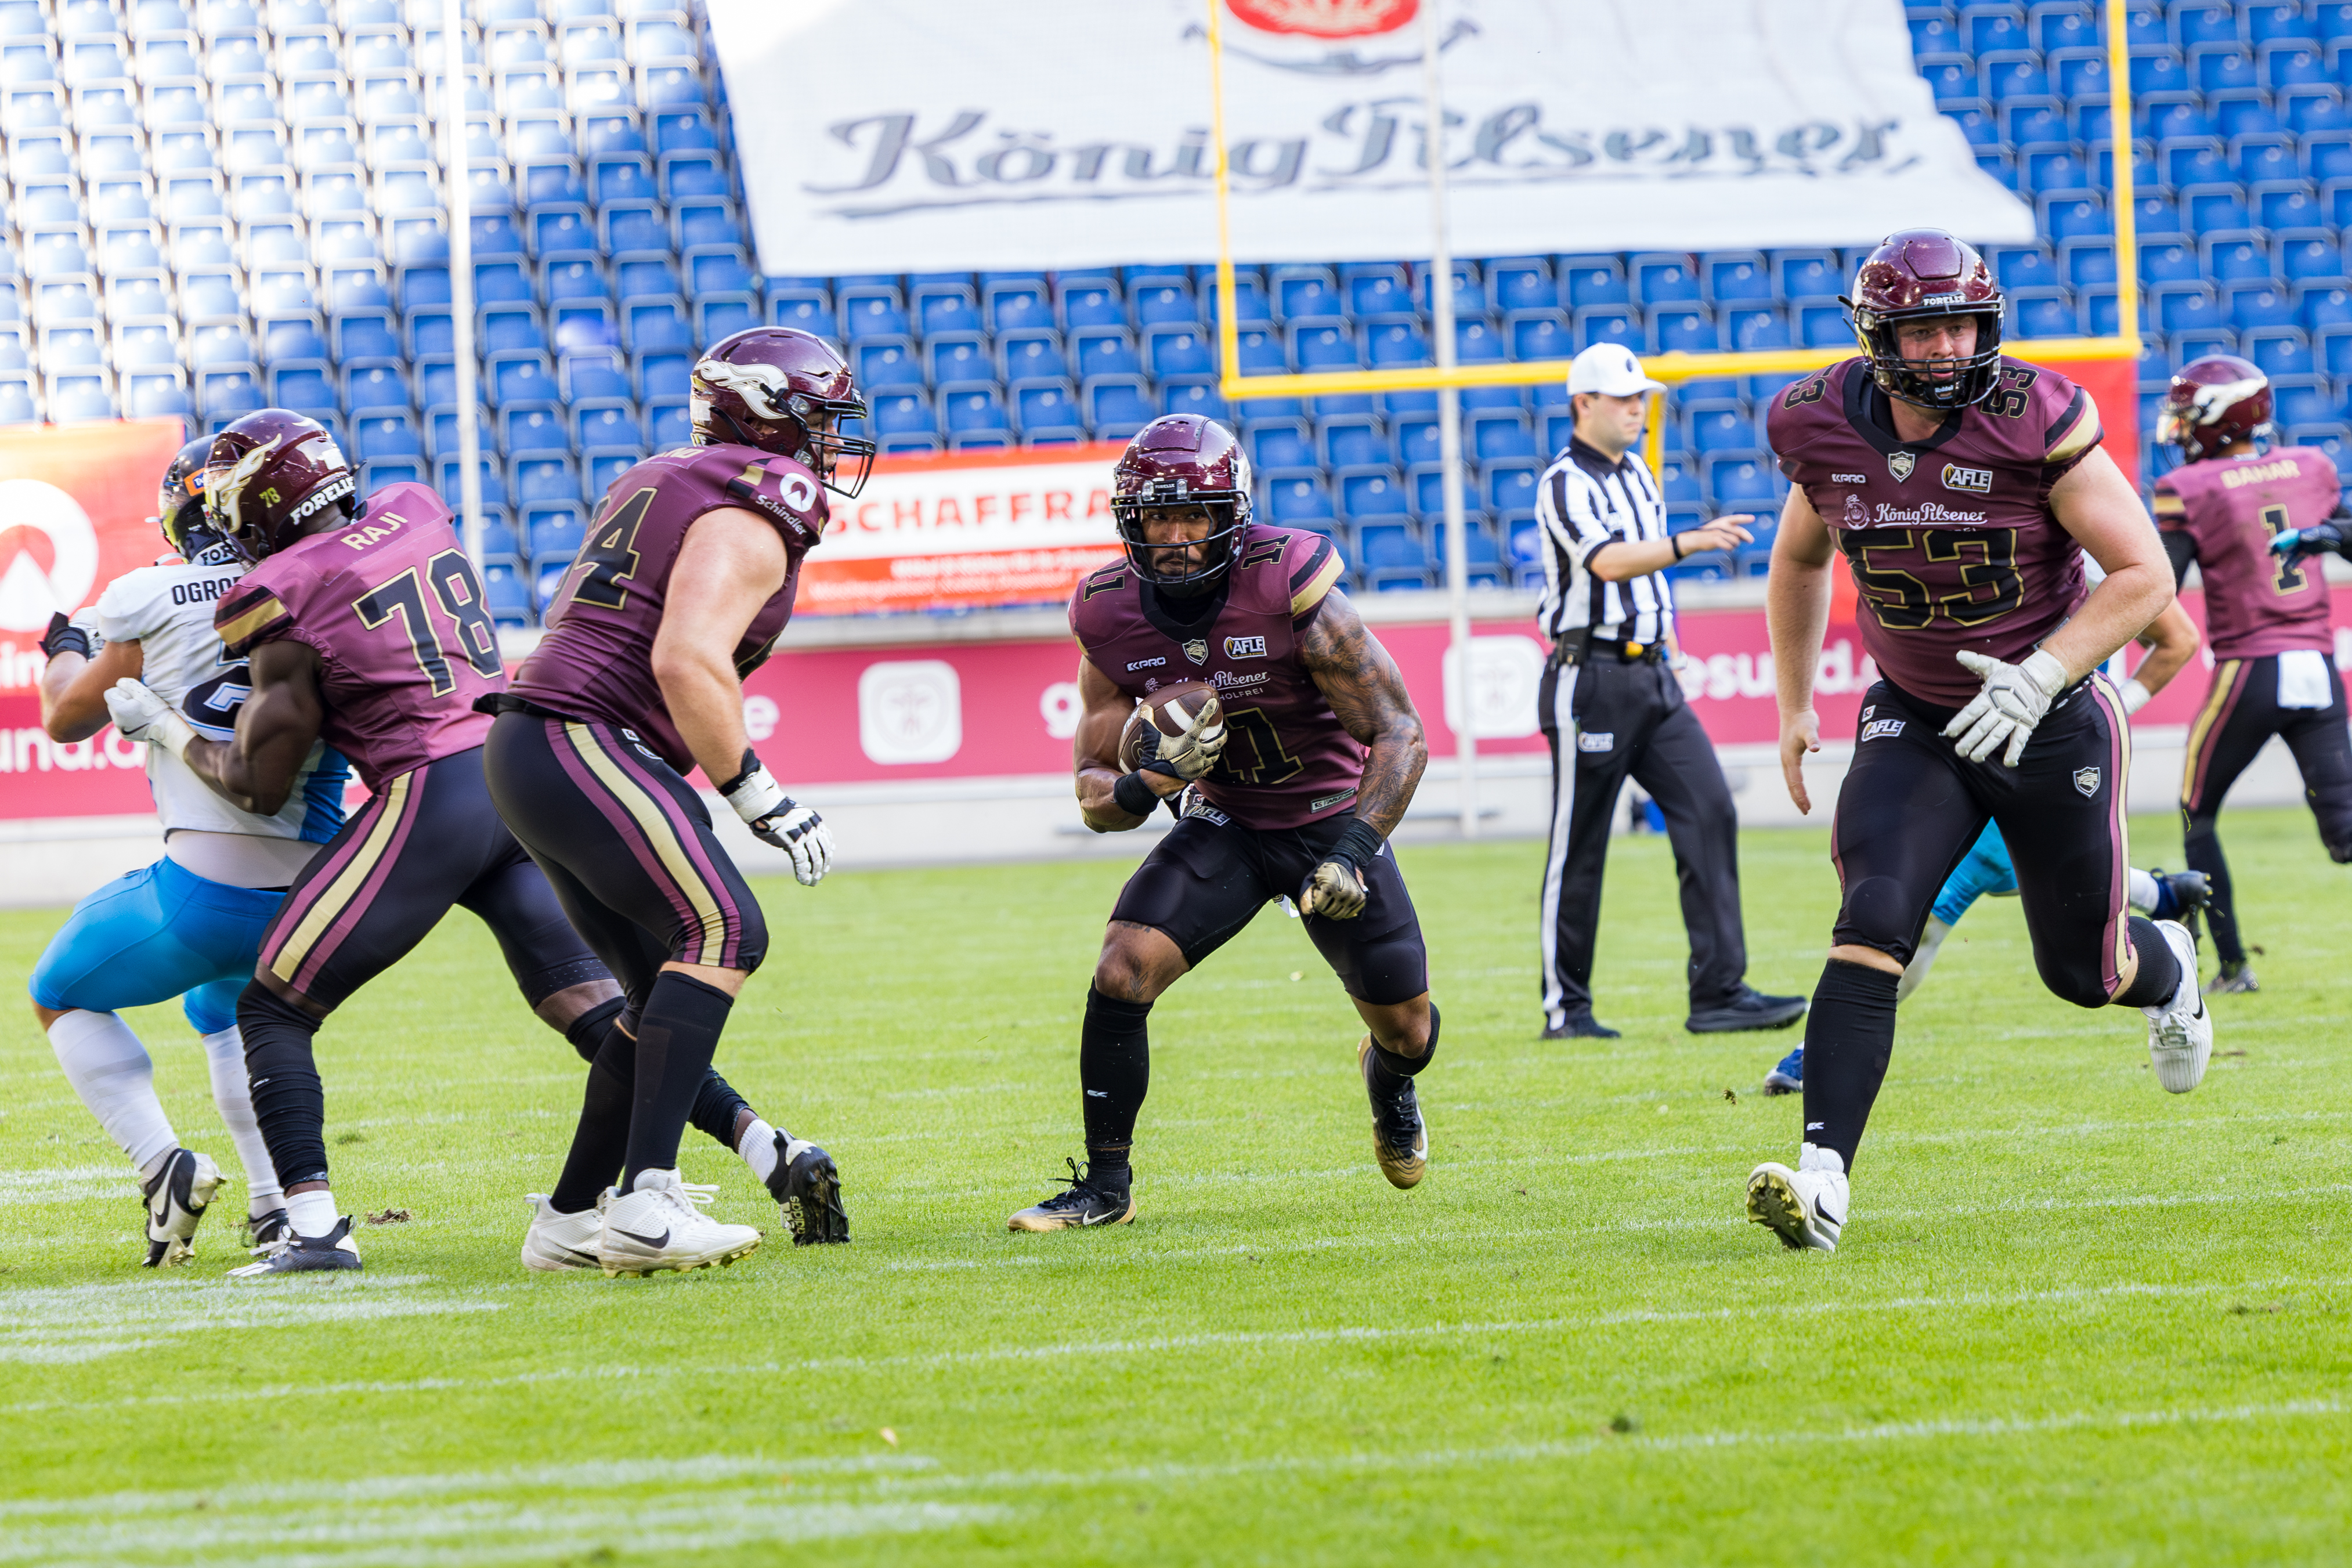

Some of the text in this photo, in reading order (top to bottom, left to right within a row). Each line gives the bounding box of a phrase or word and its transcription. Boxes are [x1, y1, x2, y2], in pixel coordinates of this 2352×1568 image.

[1923, 295, 1966, 306] FORELLE
[1949, 468, 1990, 487] AFLE
[2220, 459, 2302, 490] BAHAR
[258, 487, 281, 508] 78
[289, 475, 356, 526] FORELLE
[755, 494, 807, 536] Schindler
[339, 511, 409, 551] RAJI
[2258, 503, 2309, 597] 1
[1240, 534, 1294, 570] 11
[1837, 528, 2024, 630] 53
[351, 547, 503, 699] 78
[1232, 639, 1263, 655] AFLE
[1865, 720, 1903, 737] AFLE
[789, 1195, 806, 1235] adidas
